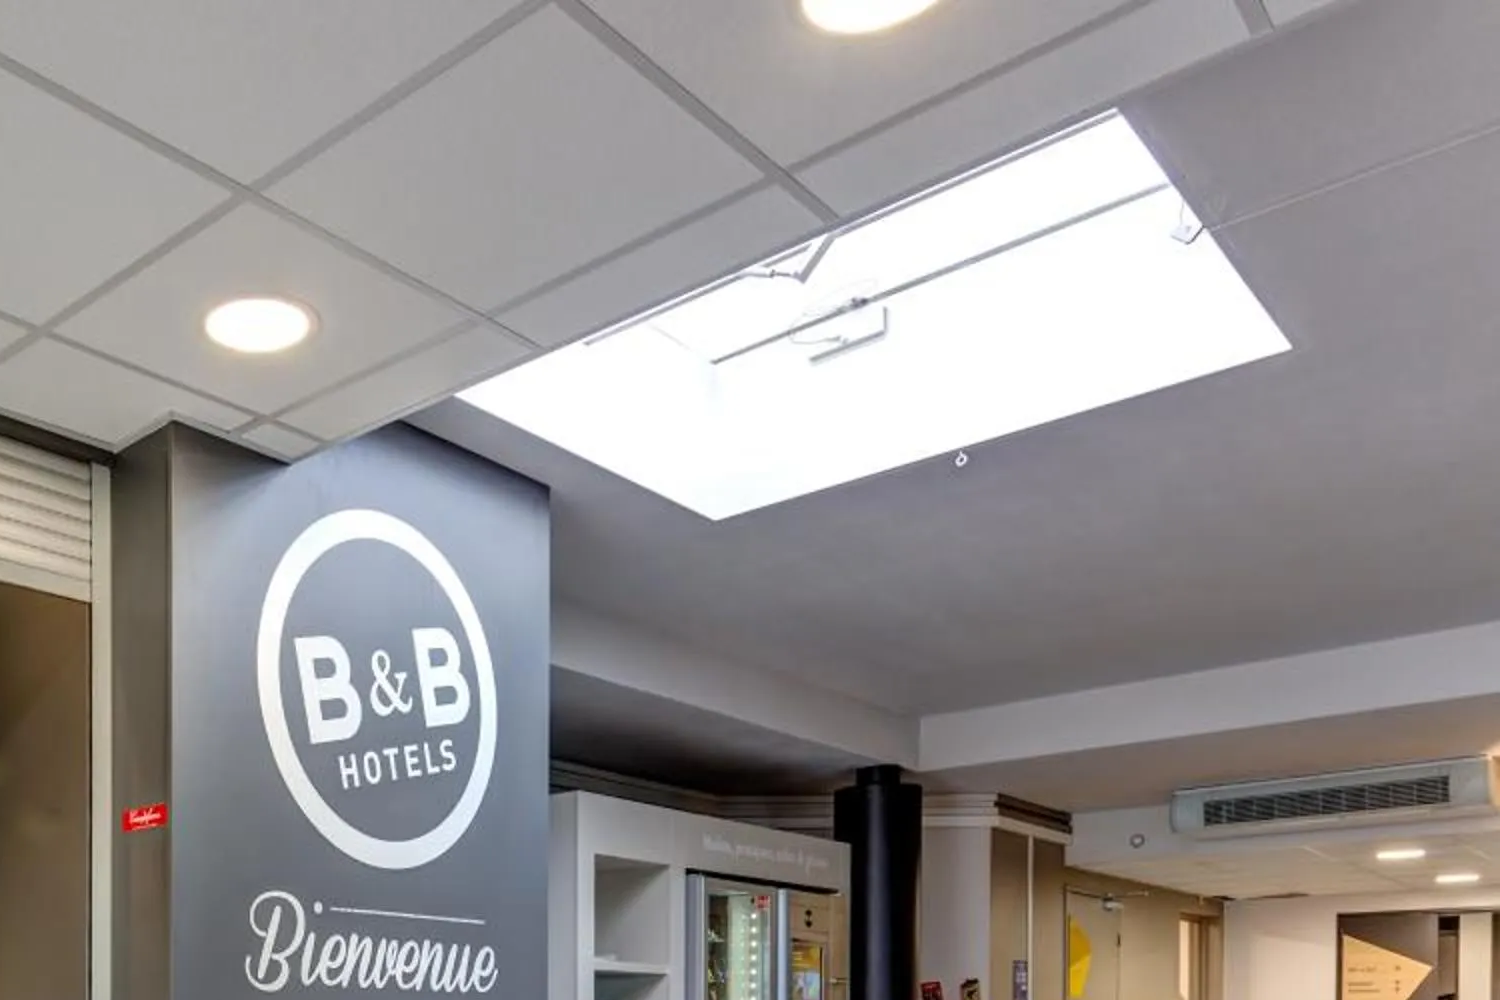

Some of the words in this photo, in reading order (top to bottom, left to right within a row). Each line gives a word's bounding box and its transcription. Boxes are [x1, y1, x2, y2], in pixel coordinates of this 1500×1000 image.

[294, 627, 471, 744] B&B
[338, 739, 457, 790] HOTELS
[245, 890, 498, 992] Bienvenue
